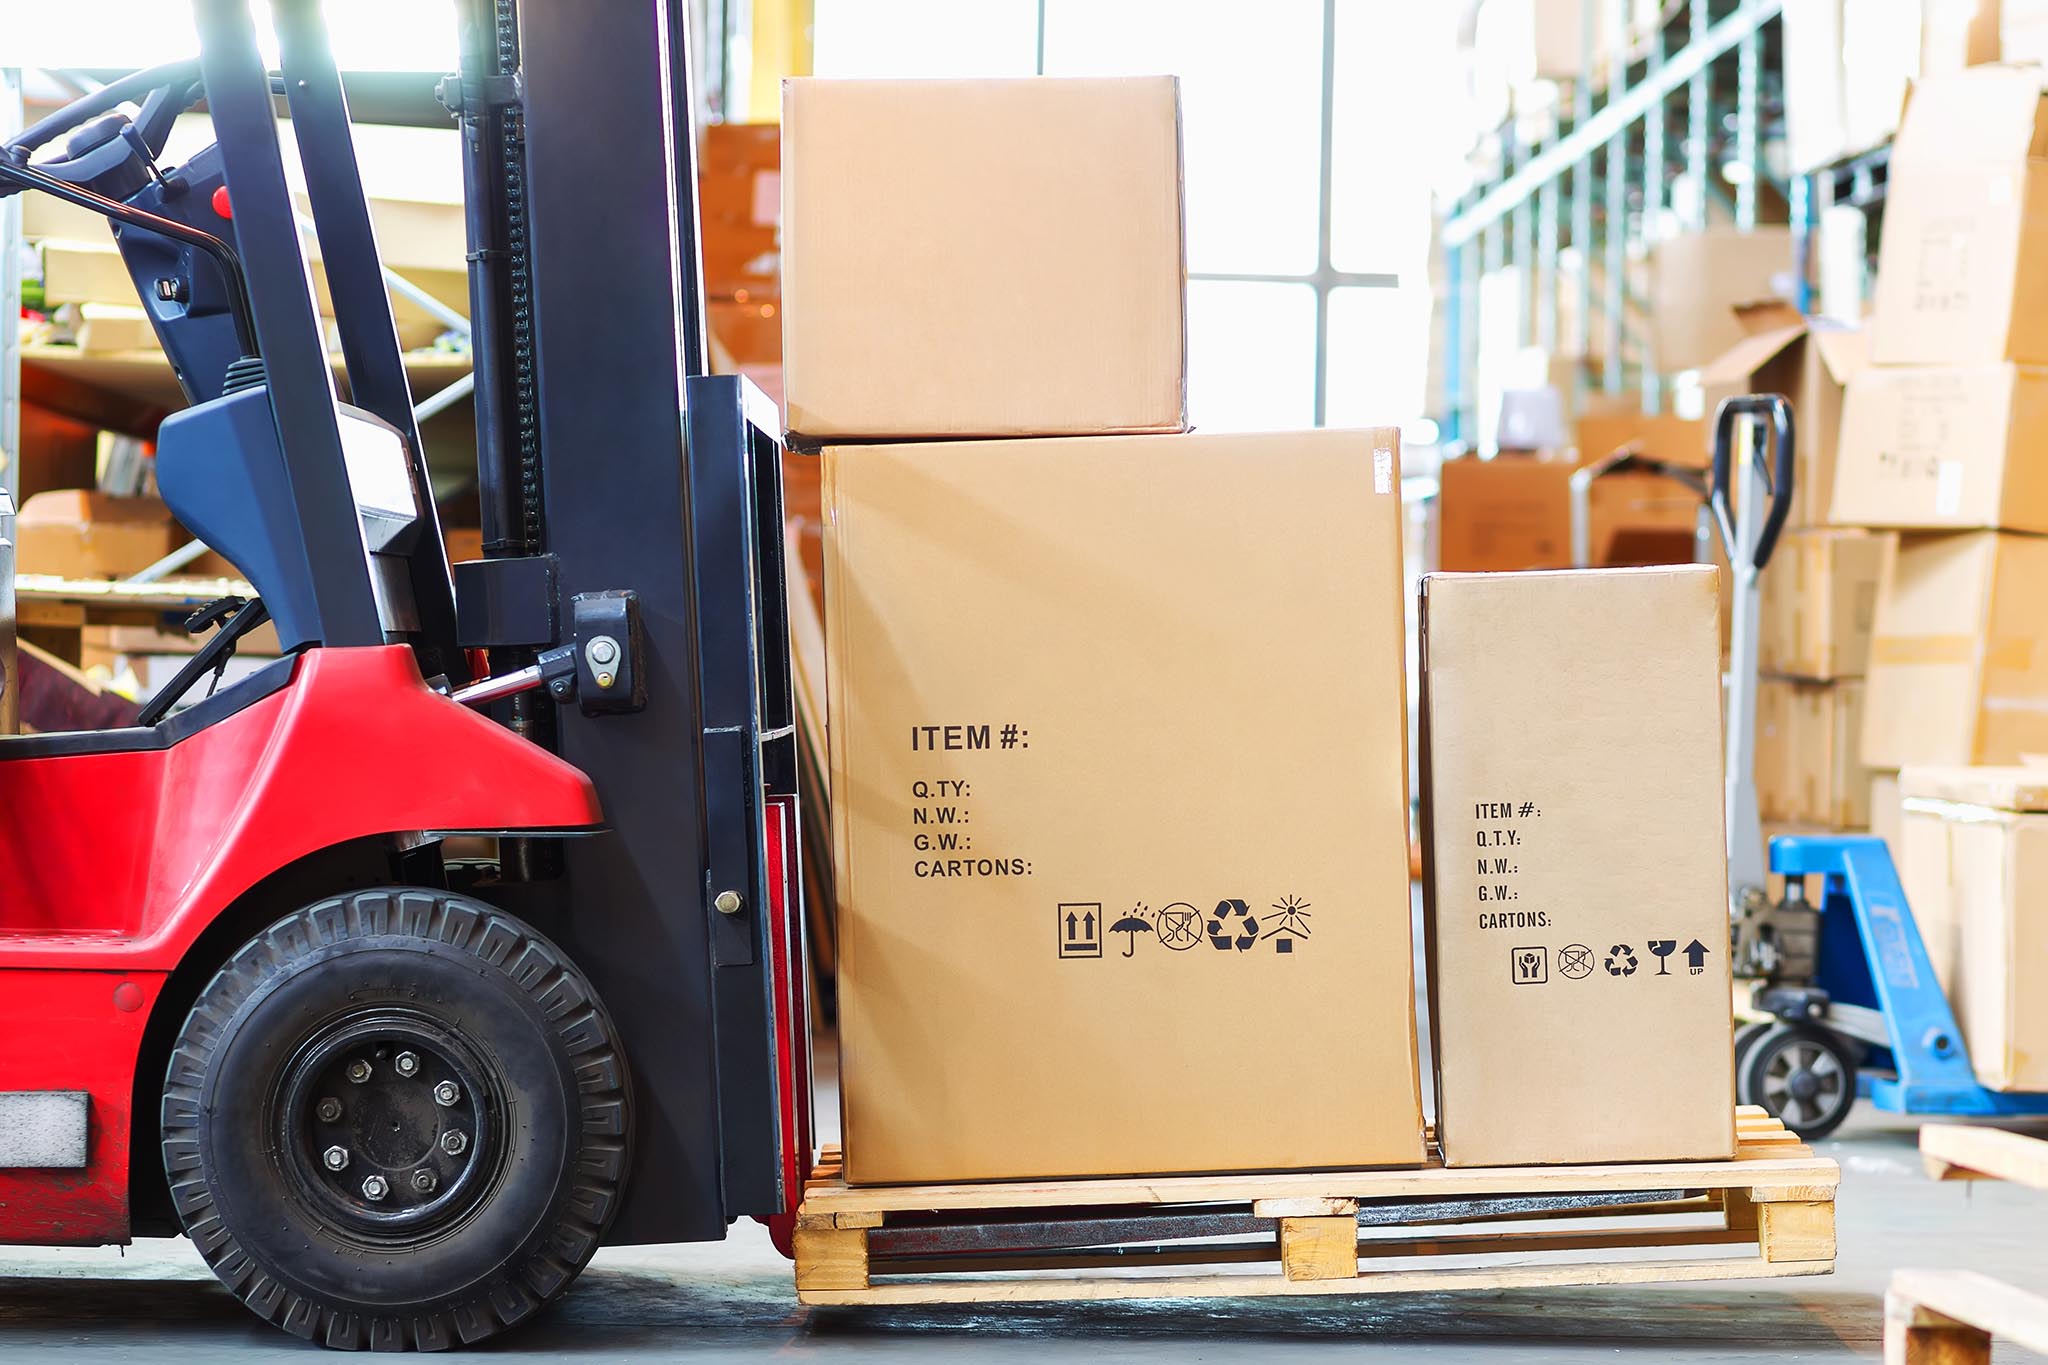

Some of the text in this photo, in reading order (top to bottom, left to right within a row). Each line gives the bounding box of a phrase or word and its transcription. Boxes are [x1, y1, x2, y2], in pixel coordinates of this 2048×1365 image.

[911, 724, 1029, 751] ITEM #:
[912, 780, 971, 798] Q.TY:
[913, 807, 969, 825] N.W.:
[1475, 803, 1512, 819] ITEM
[913, 833, 971, 851] G.W.:
[1476, 829, 1521, 847] Q.T.Y:
[914, 858, 1032, 878] CARTONS:
[1477, 858, 1518, 875] N.W.:
[1478, 885, 1518, 901] G.W.:
[1479, 911, 1551, 929] CARTONS:
[1690, 967, 1704, 976] UP
